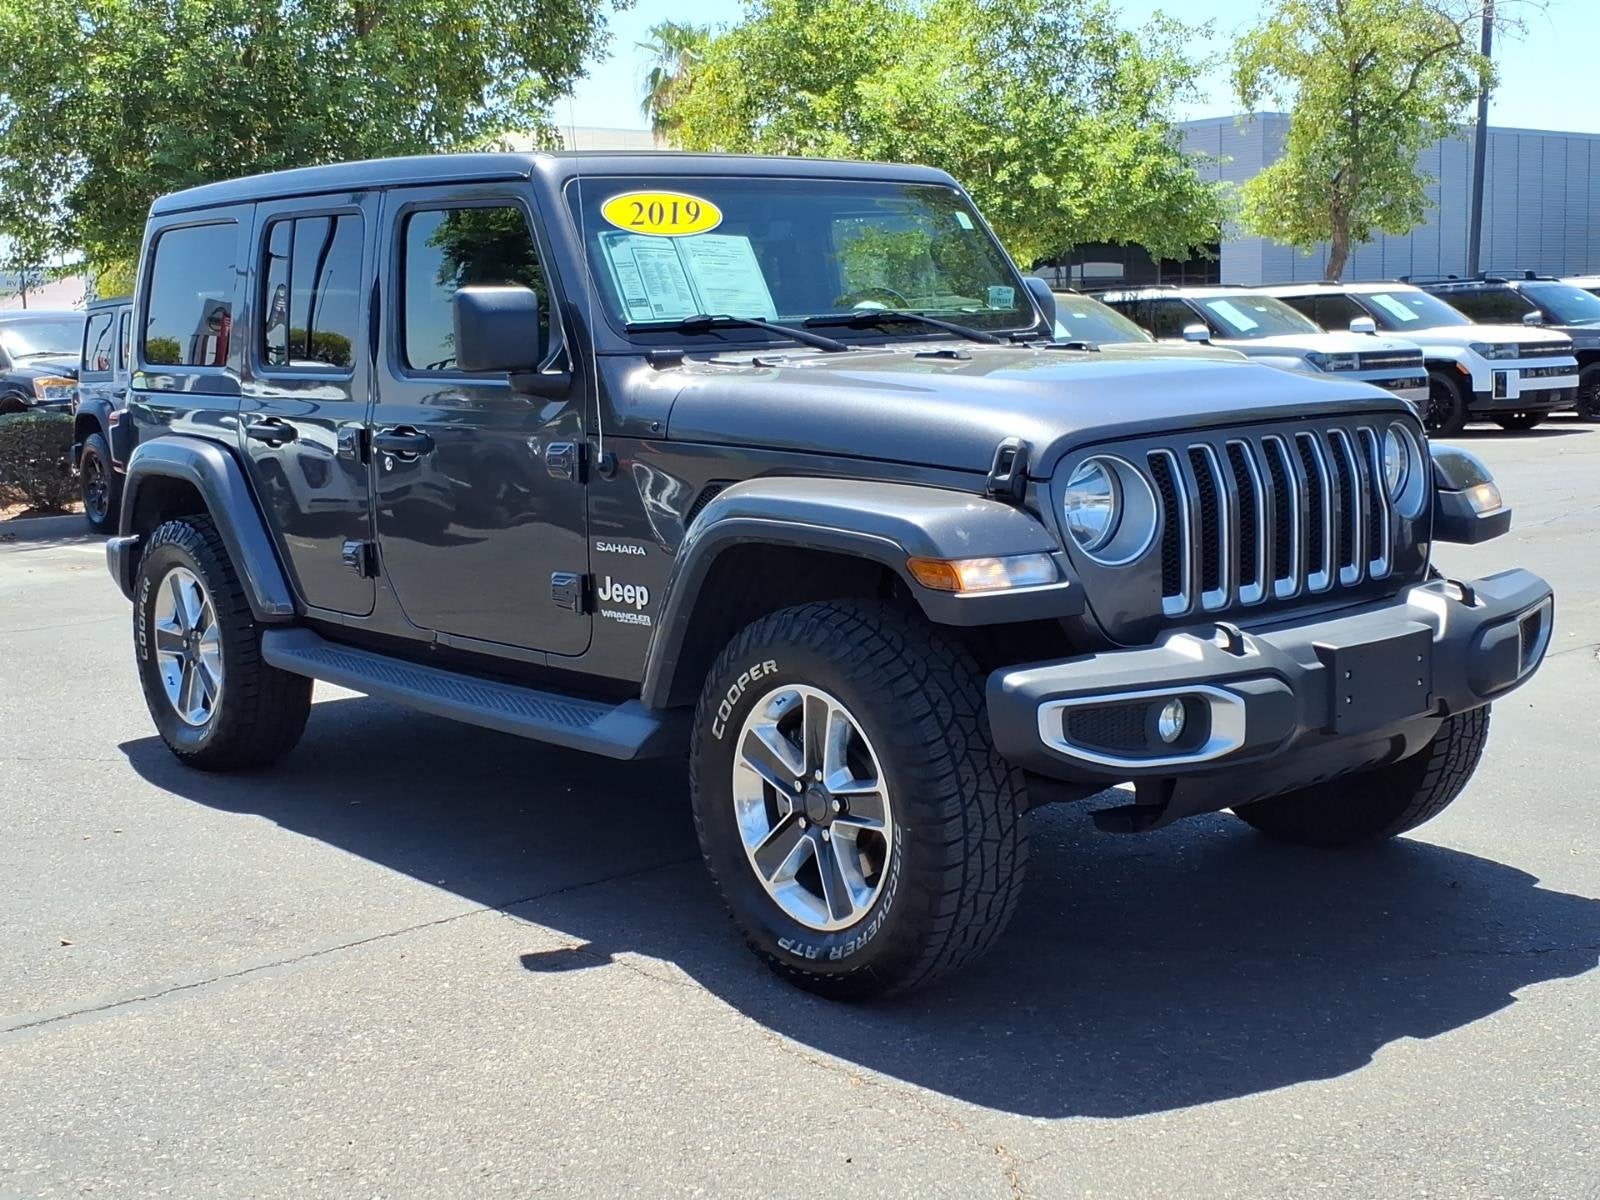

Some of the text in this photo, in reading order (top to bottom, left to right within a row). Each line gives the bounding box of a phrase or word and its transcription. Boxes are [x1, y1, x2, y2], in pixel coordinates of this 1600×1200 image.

[629, 200, 701, 226] 2019
[595, 541, 646, 556] SAHARA
[598, 575, 649, 610] Jeep
[138, 576, 151, 661] COOPER
[601, 609, 650, 622] WRANGLER
[711, 659, 779, 741] COOPER
[829, 823, 902, 961] DISCOVERER
